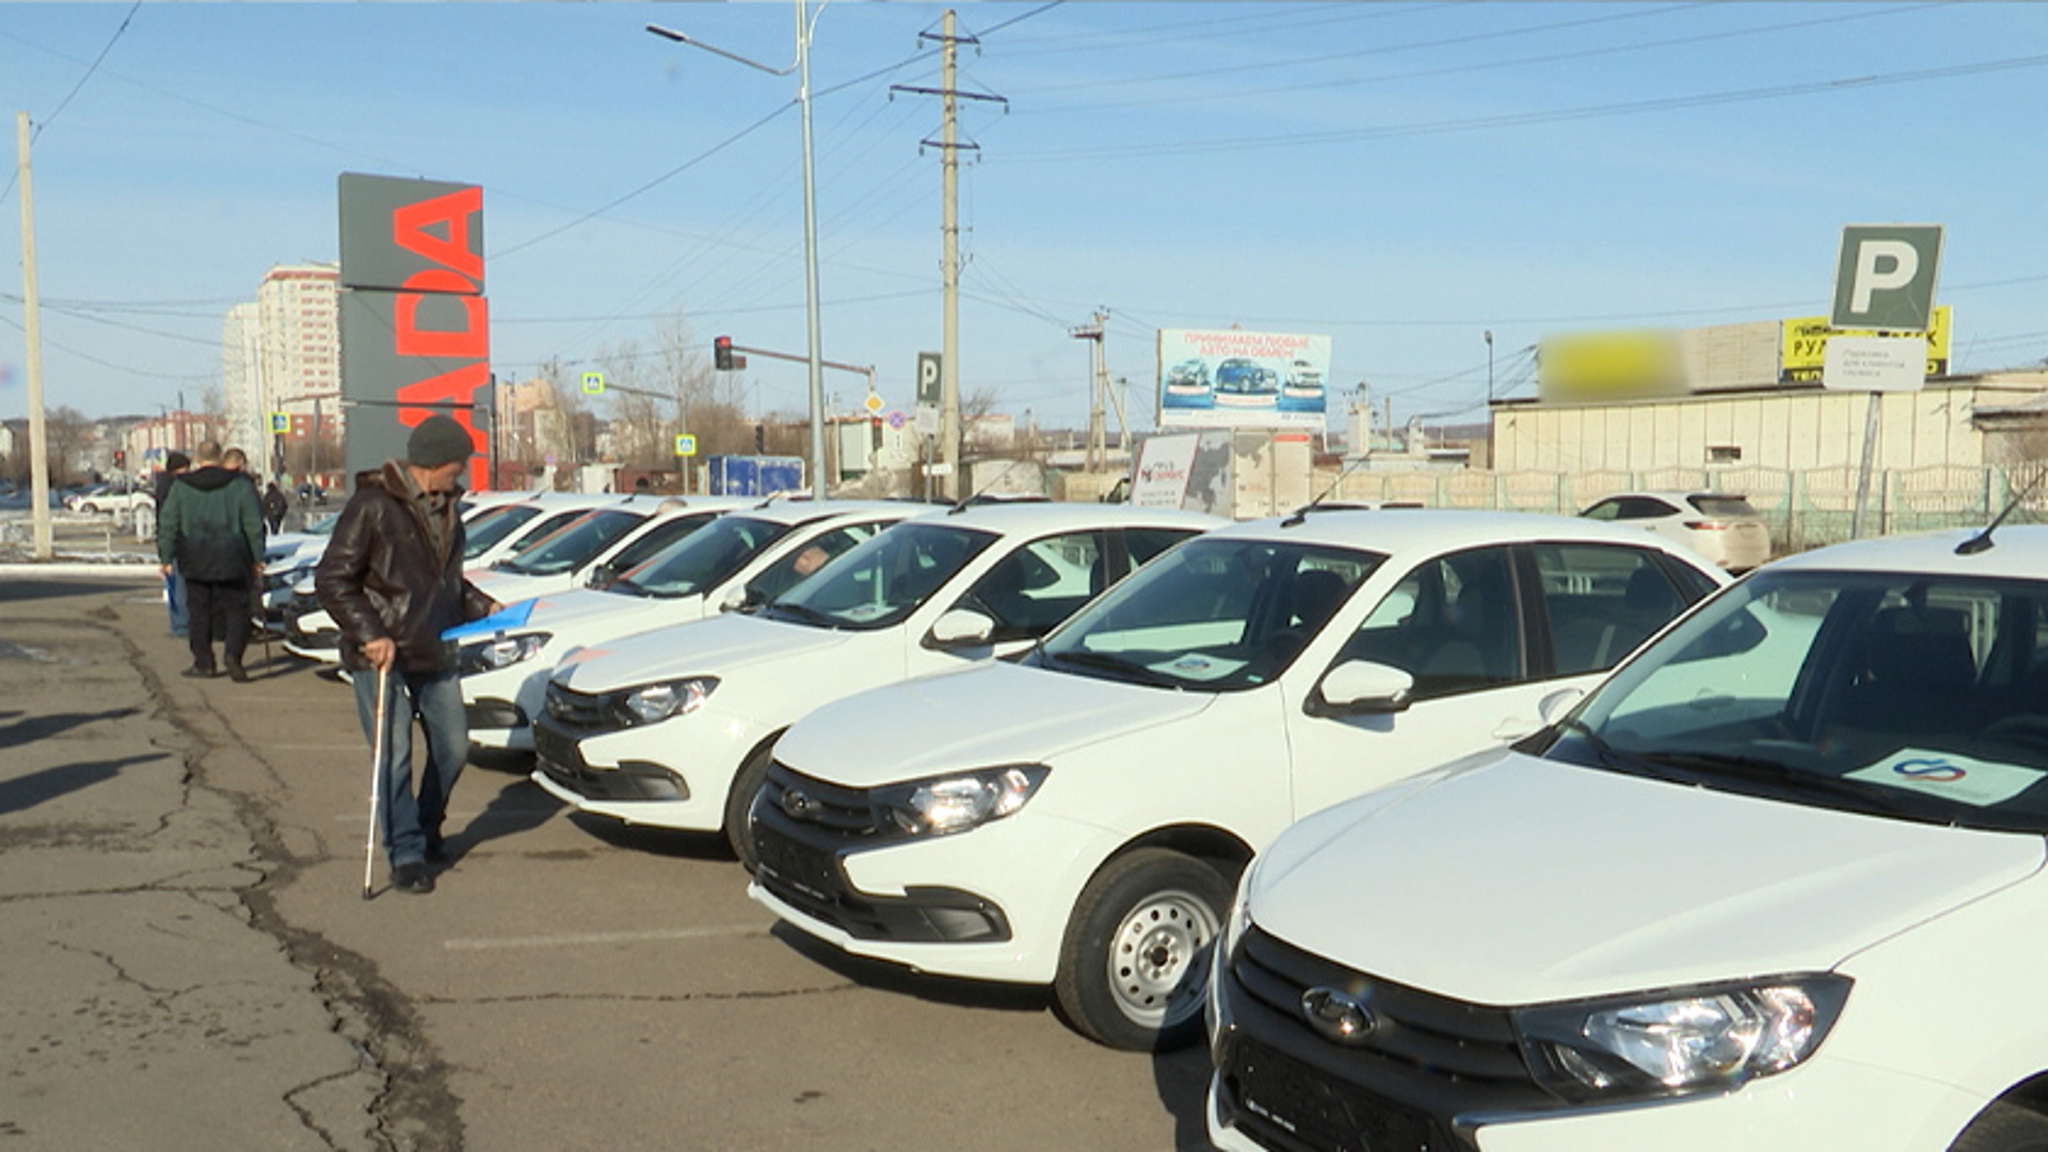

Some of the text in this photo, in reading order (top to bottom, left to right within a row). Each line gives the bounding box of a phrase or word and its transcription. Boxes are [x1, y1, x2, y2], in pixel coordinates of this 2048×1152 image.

[1850, 240, 1919, 313] P
[1184, 332, 1310, 348] ПРИНИМАЕМ ЛЮБЫЕ
[1200, 345, 1295, 358] АВТО НА ОБМЕН
[921, 358, 938, 395] P
